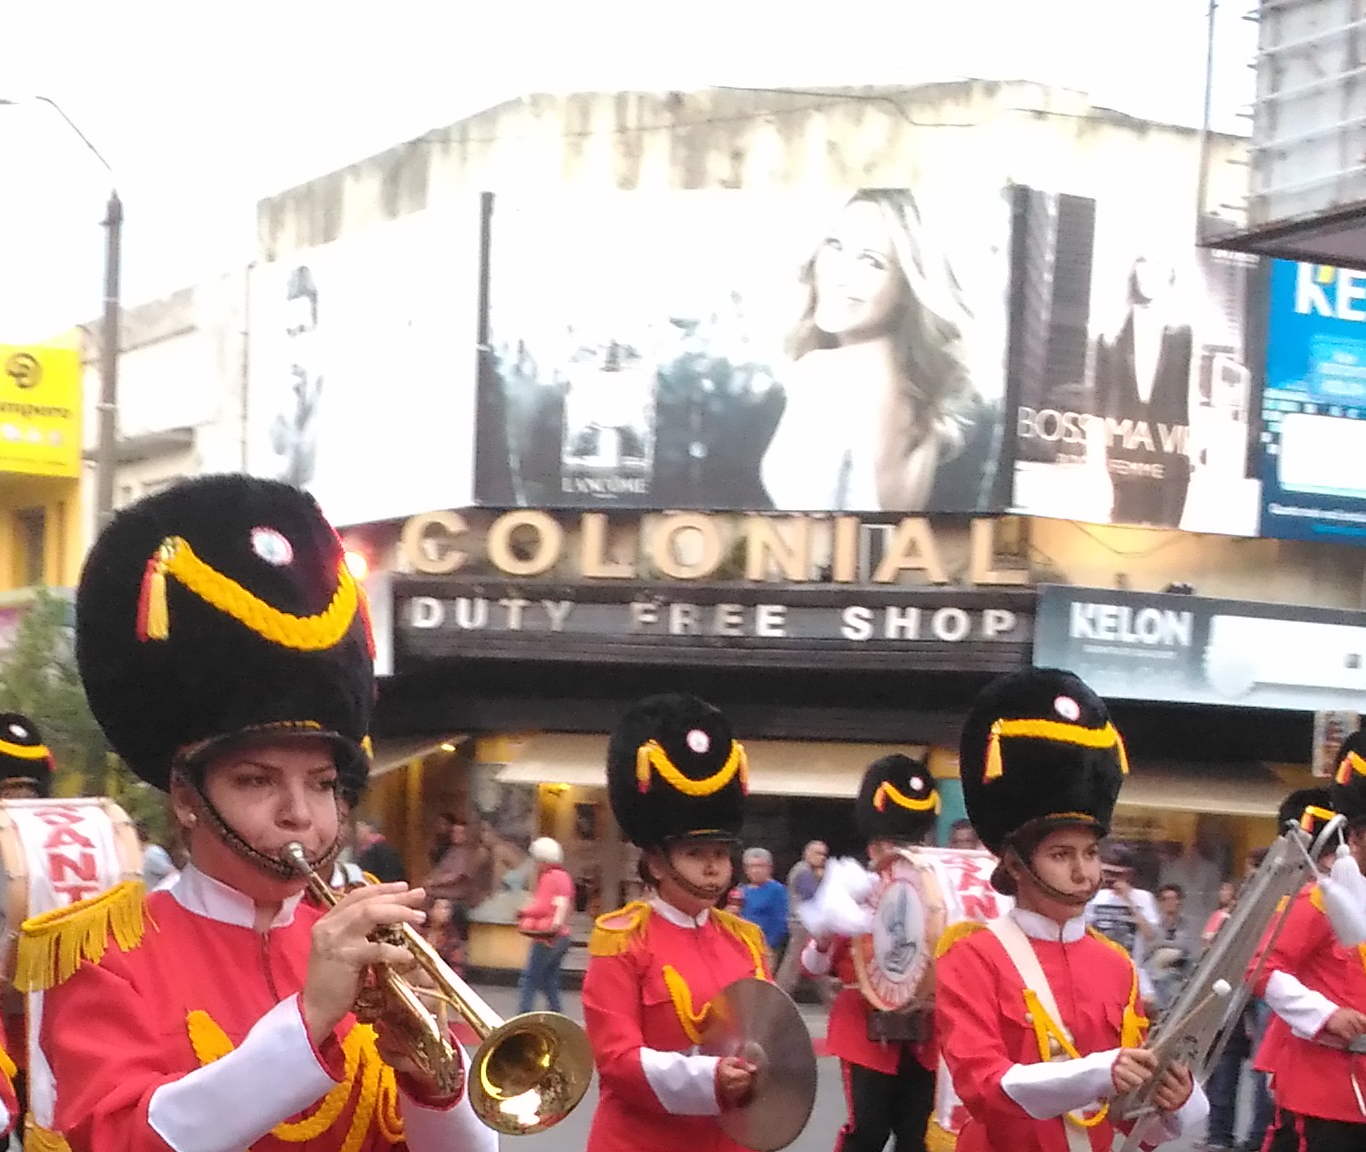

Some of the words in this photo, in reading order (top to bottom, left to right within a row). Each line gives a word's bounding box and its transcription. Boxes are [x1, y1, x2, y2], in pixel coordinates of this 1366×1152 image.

[1156, 422, 1189, 454] VI
[400, 509, 1030, 586] COLONIAL
[410, 596, 575, 632] DUTY
[631, 601, 788, 637] FREE
[840, 605, 1018, 642] SHOP
[1070, 602, 1194, 647] KELON
